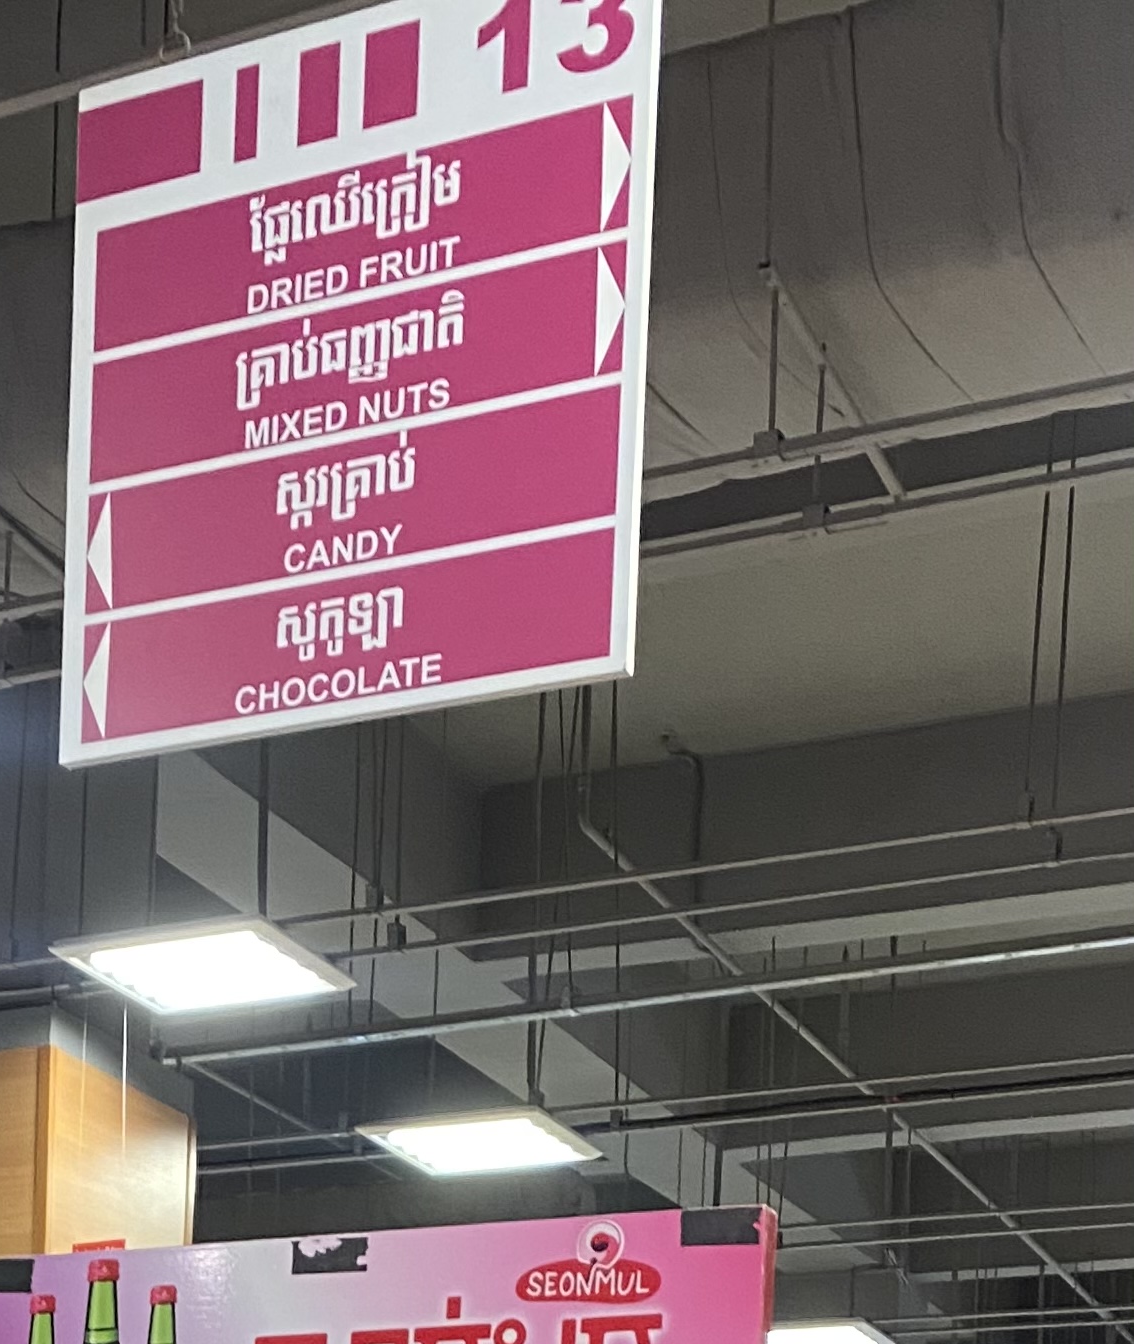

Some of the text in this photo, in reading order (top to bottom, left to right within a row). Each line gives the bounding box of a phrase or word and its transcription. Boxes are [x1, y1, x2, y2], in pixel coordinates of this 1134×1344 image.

[477, 0, 635, 93] 13
[248, 236, 460, 314] DRIED FRUIT
[245, 378, 450, 449] MIXED NUTS
[283, 525, 403, 573] CANDY
[235, 654, 442, 716] CHOCOLATE
[525, 1269, 652, 1299] SEONMUL
